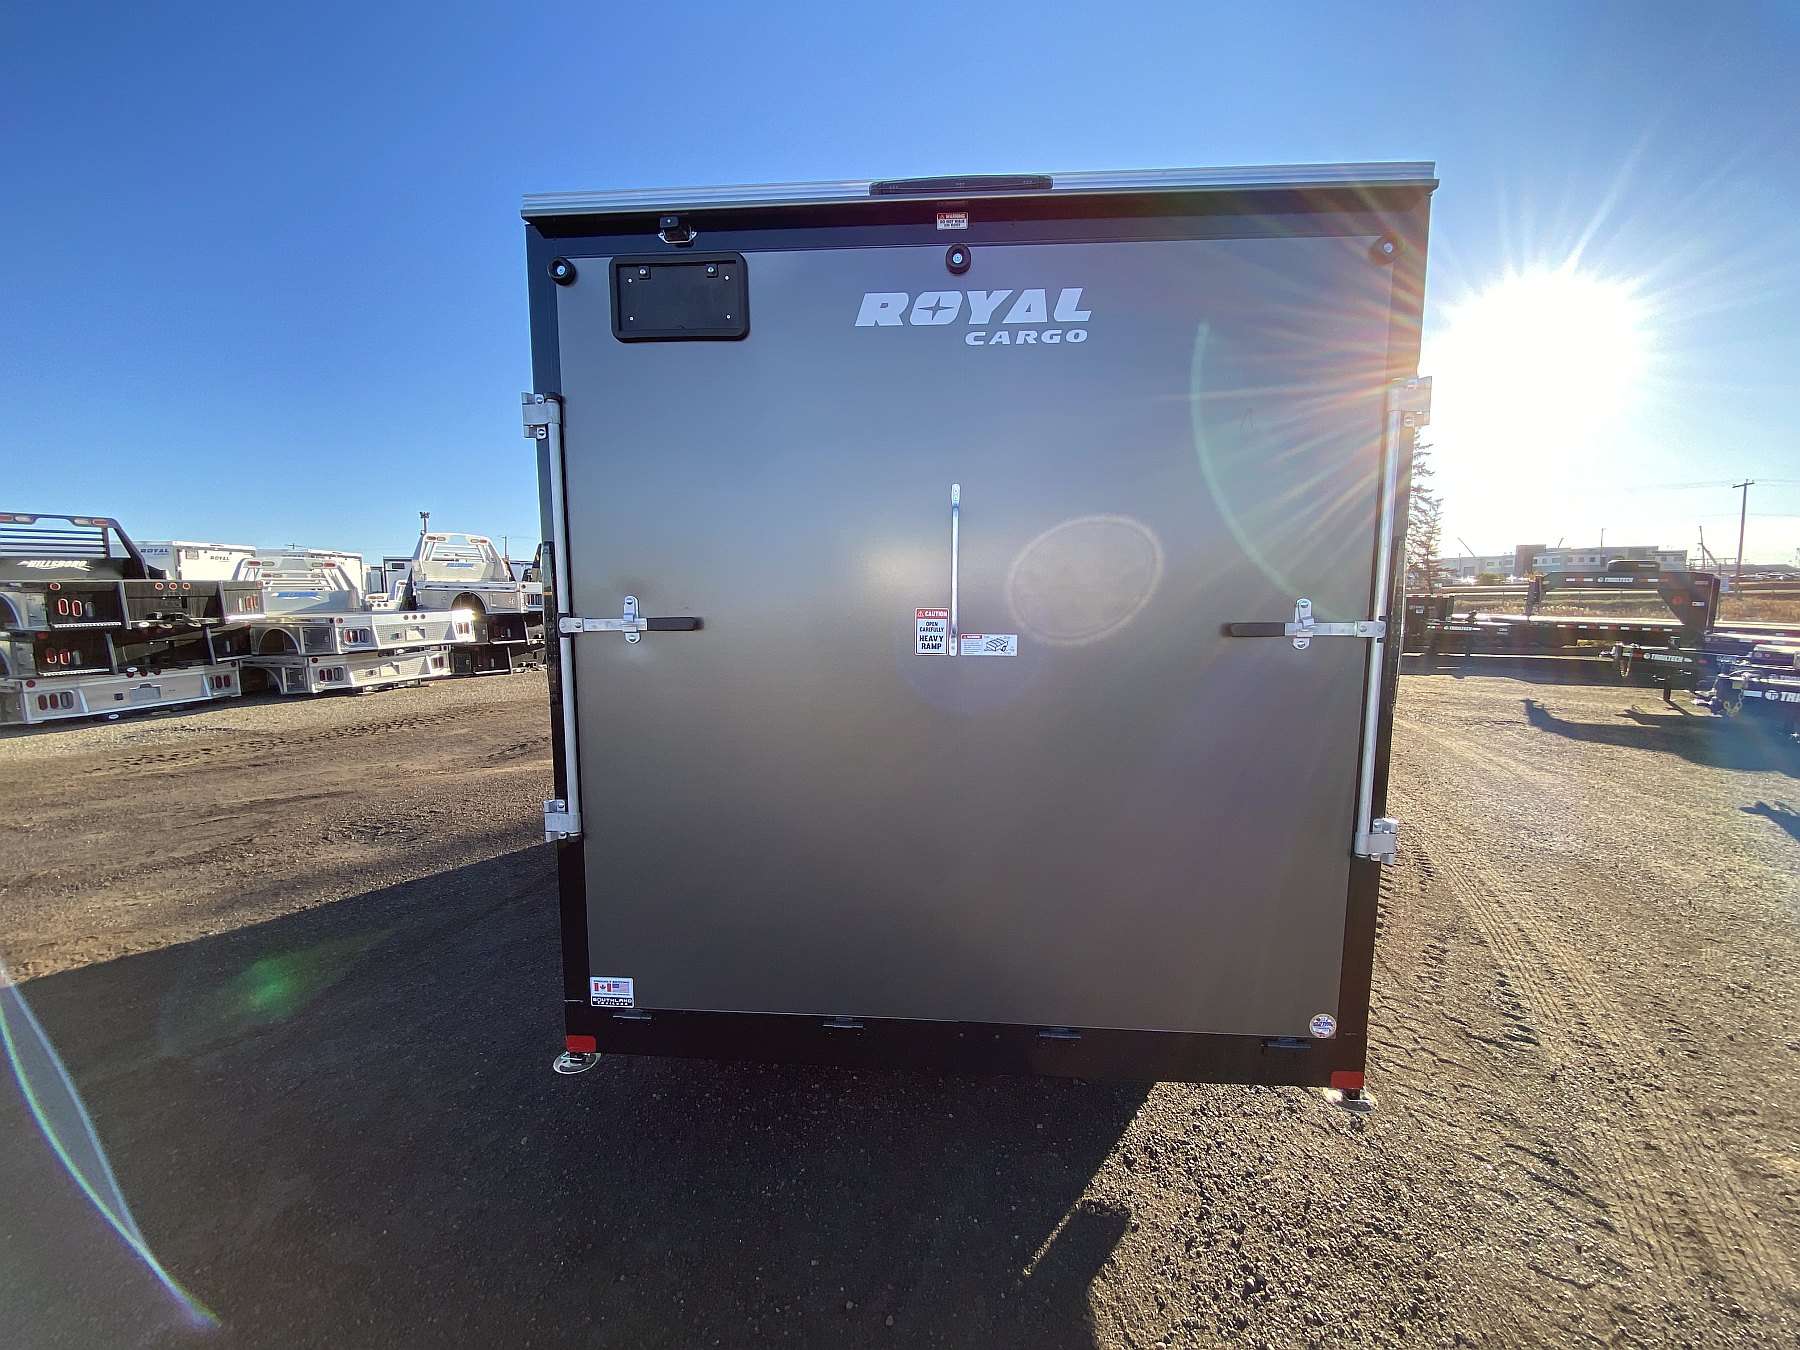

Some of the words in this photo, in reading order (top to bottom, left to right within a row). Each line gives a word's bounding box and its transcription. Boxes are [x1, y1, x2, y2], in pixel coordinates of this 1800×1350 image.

[855, 287, 1092, 327] ROYAL
[965, 329, 1088, 346] CARGO
[919, 634, 944, 642] HEAVY
[921, 642, 942, 650] RAMP
